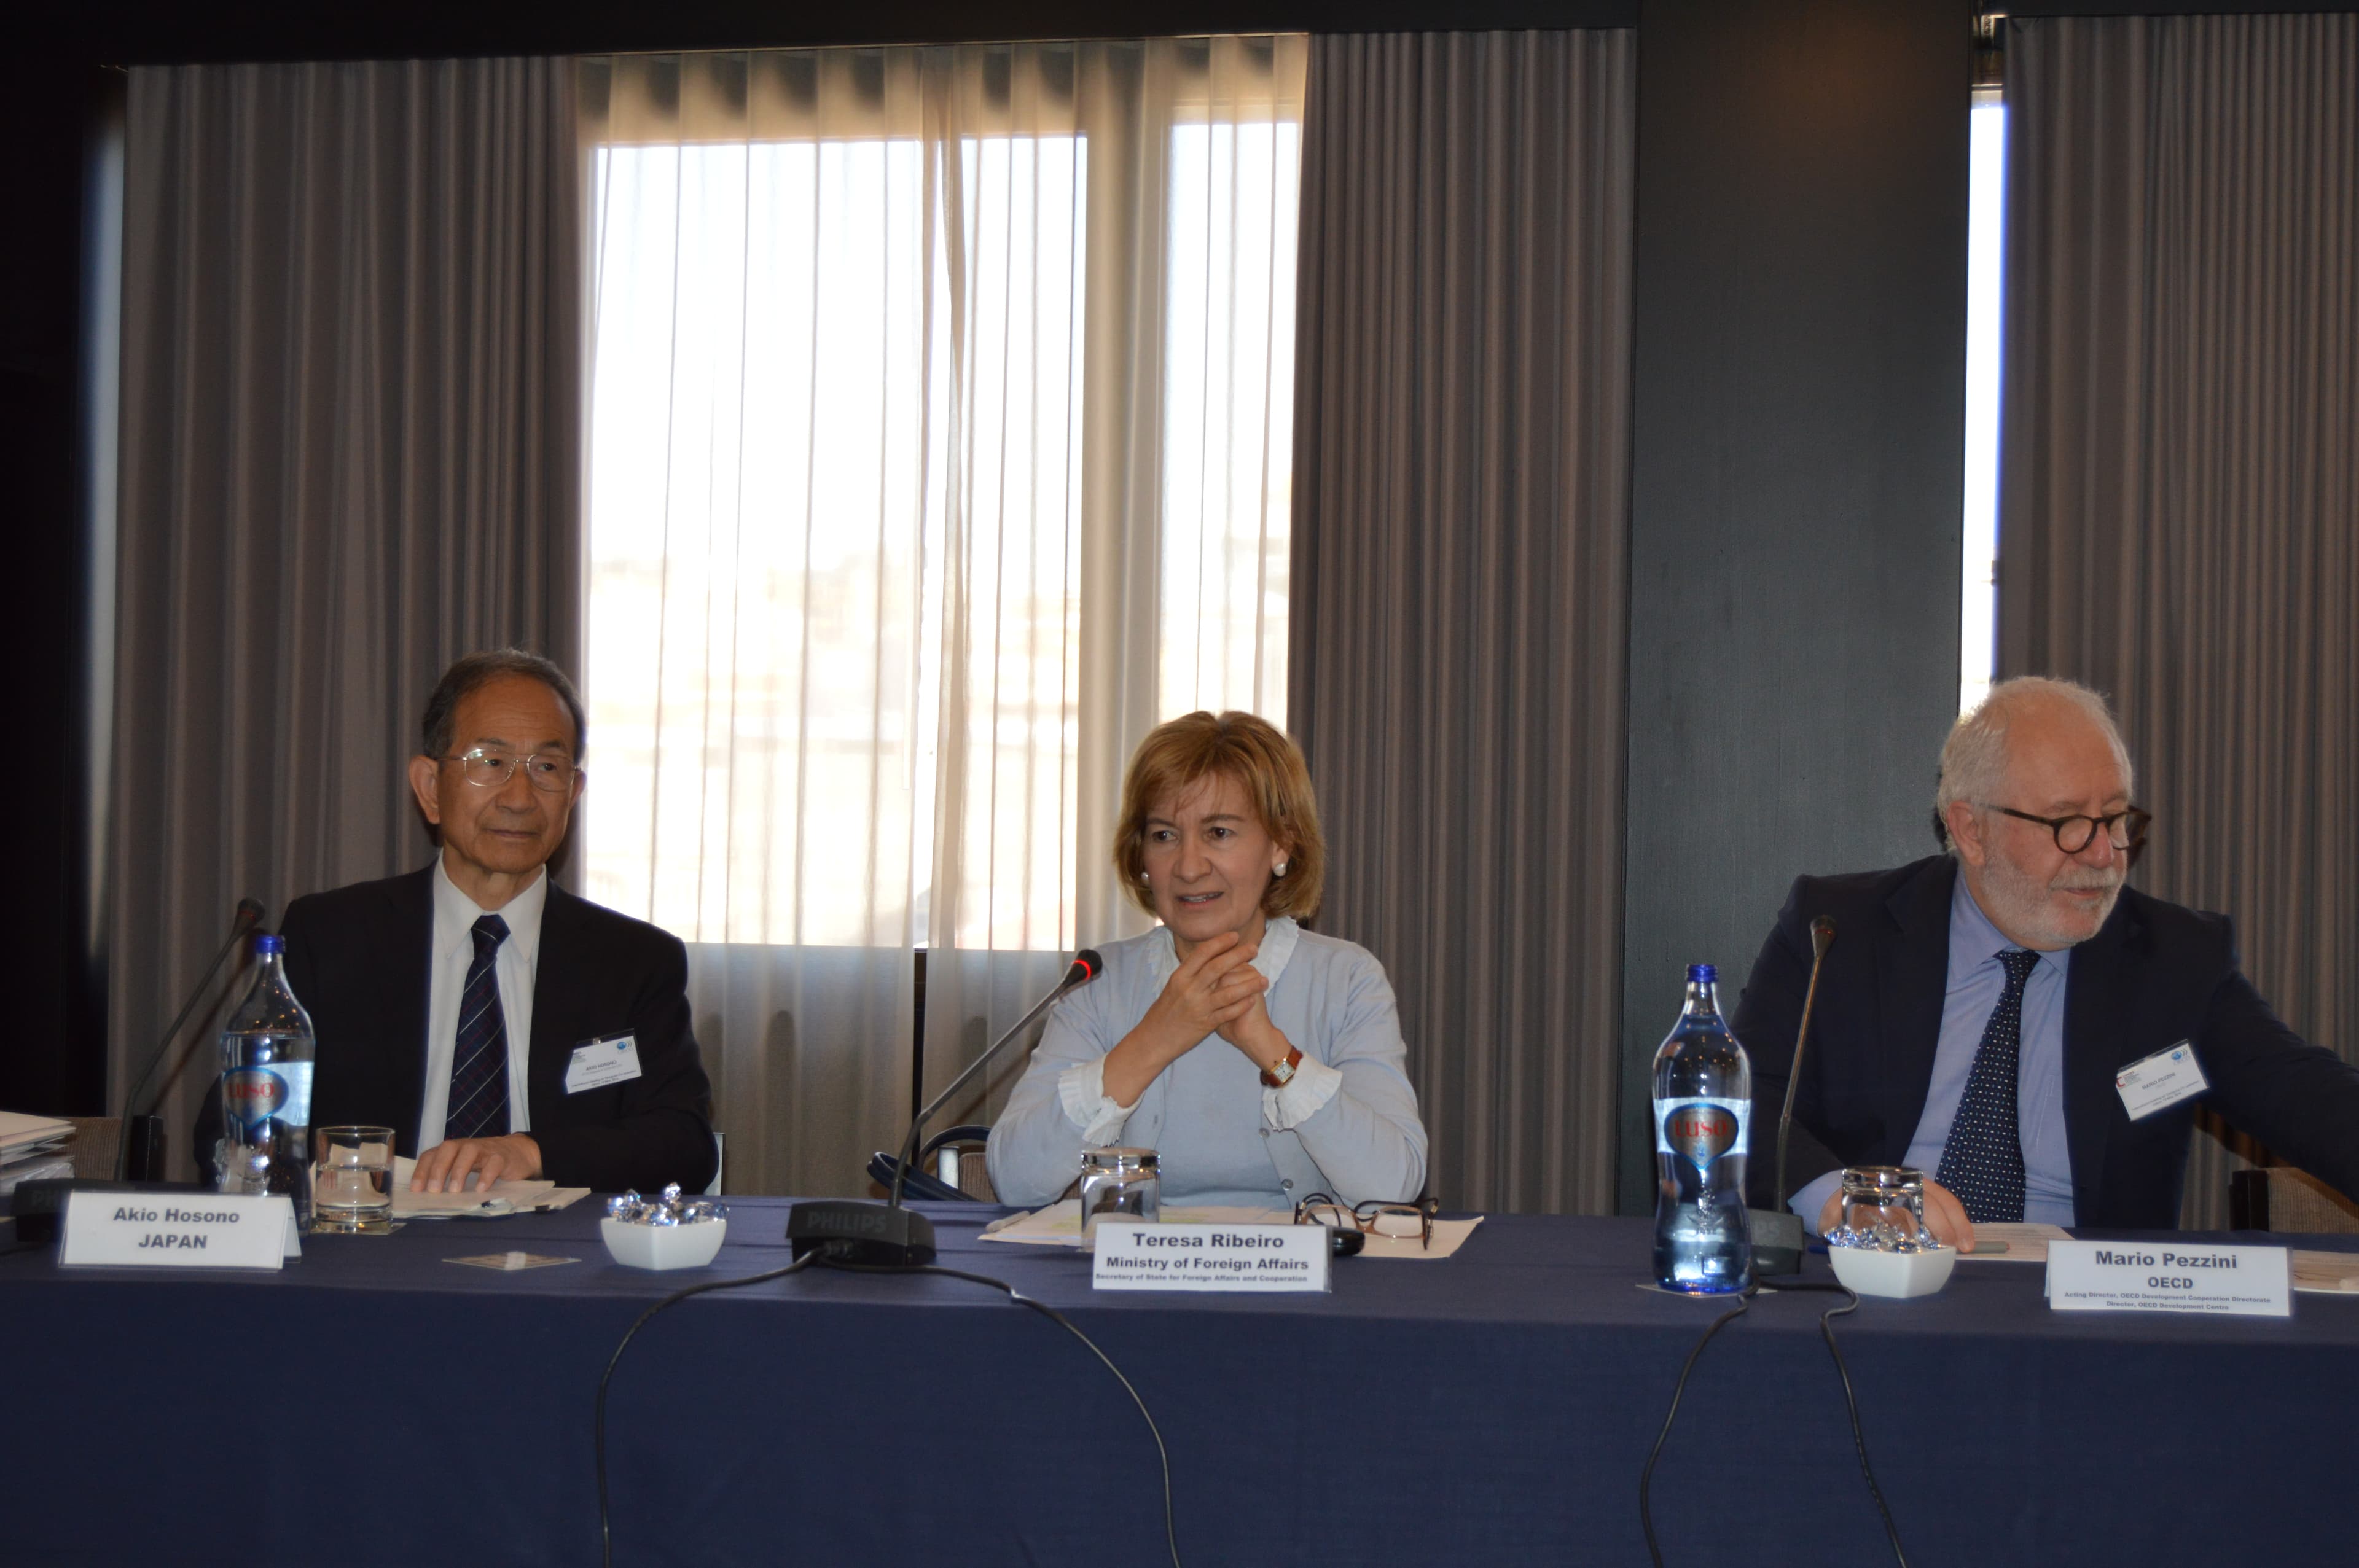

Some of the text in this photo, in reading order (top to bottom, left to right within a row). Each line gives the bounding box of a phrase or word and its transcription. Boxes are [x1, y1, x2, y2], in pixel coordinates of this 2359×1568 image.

[228, 1082, 275, 1098] LUSO
[1675, 1120, 1728, 1137] LUSO
[113, 1207, 240, 1223] Akio Hosono
[807, 1211, 887, 1233] PHILIPS
[138, 1234, 208, 1249] JAPAN
[1132, 1233, 1284, 1247] Teresa Ribeiro
[1106, 1257, 1309, 1271] Ministry of Foreign Affairs
[2095, 1250, 2237, 1268] Mario Pezzini
[2148, 1277, 2193, 1289] OECD
